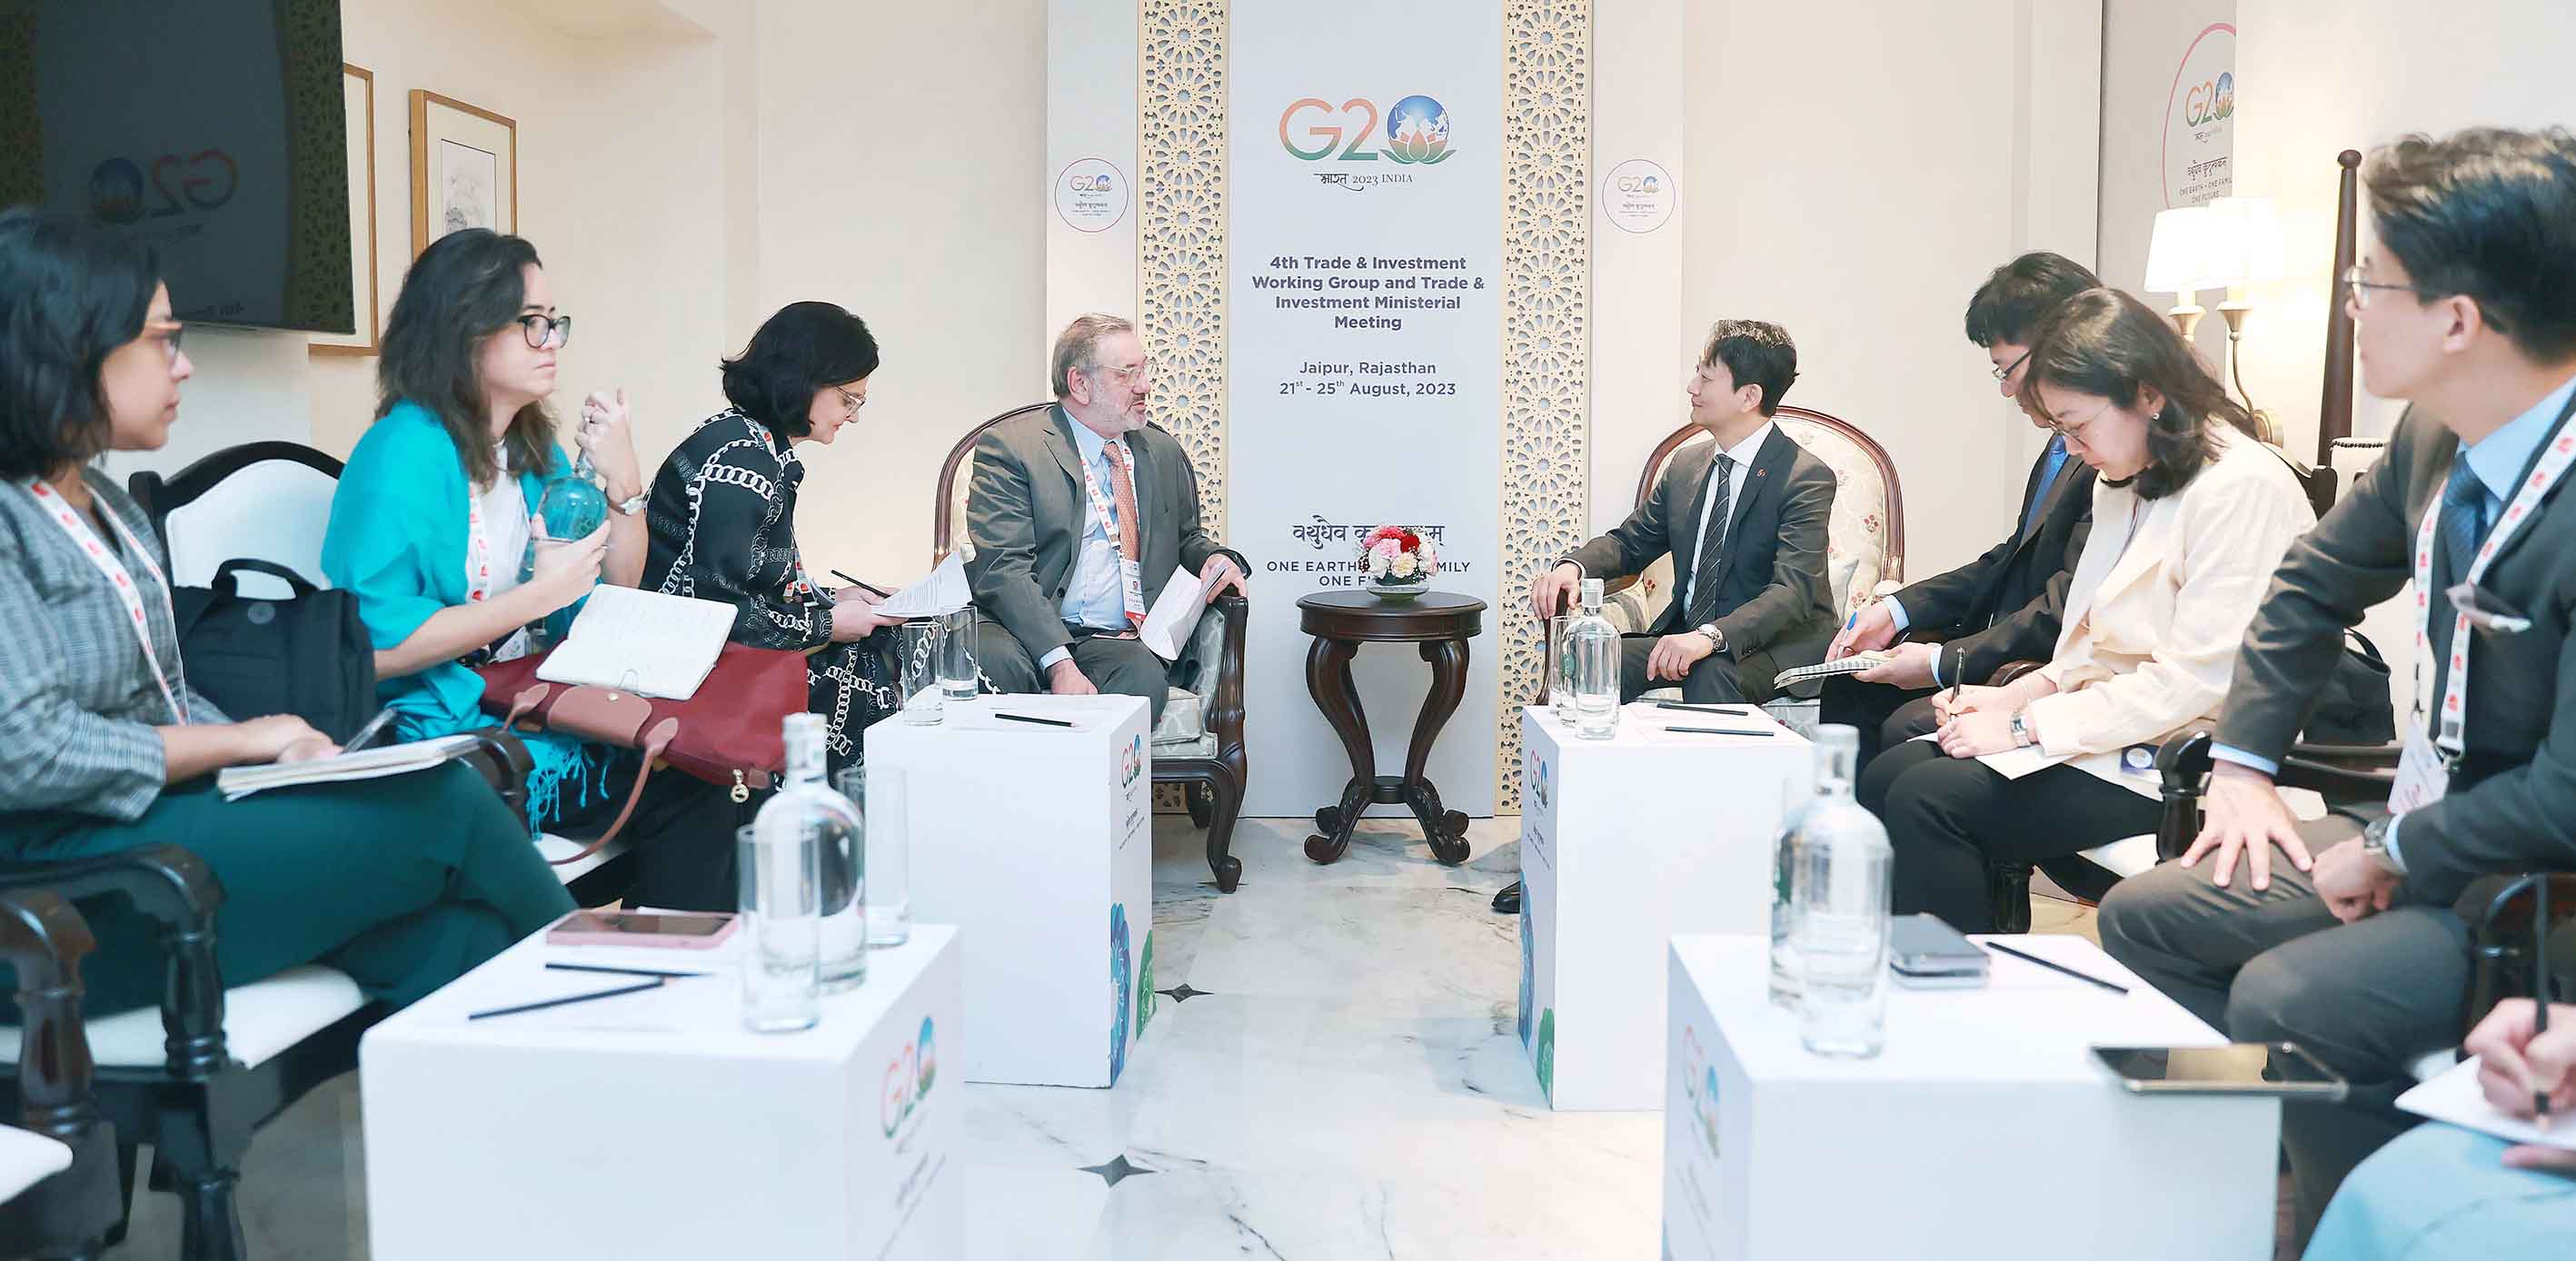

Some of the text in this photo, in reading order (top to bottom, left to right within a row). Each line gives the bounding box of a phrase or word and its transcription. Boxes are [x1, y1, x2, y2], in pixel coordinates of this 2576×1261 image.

[1278, 94, 1457, 164] G20
[1352, 174, 1414, 186] 2023 INDIA
[1269, 256, 1467, 270] 4th Trade & Investment
[1251, 275, 1485, 292] Working Group and Trade &
[1275, 295, 1461, 310] Investment Ministerial
[1334, 315, 1402, 332] Meeting
[1298, 361, 1437, 377] Jaipur, Rajasthan
[1316, 380, 1345, 395] 25th
[1348, 382, 1410, 398] August,
[1415, 382, 1456, 395] 2023
[1266, 561, 1471, 572] ONE EARTH MILY
[1318, 575, 1352, 587] ONE
